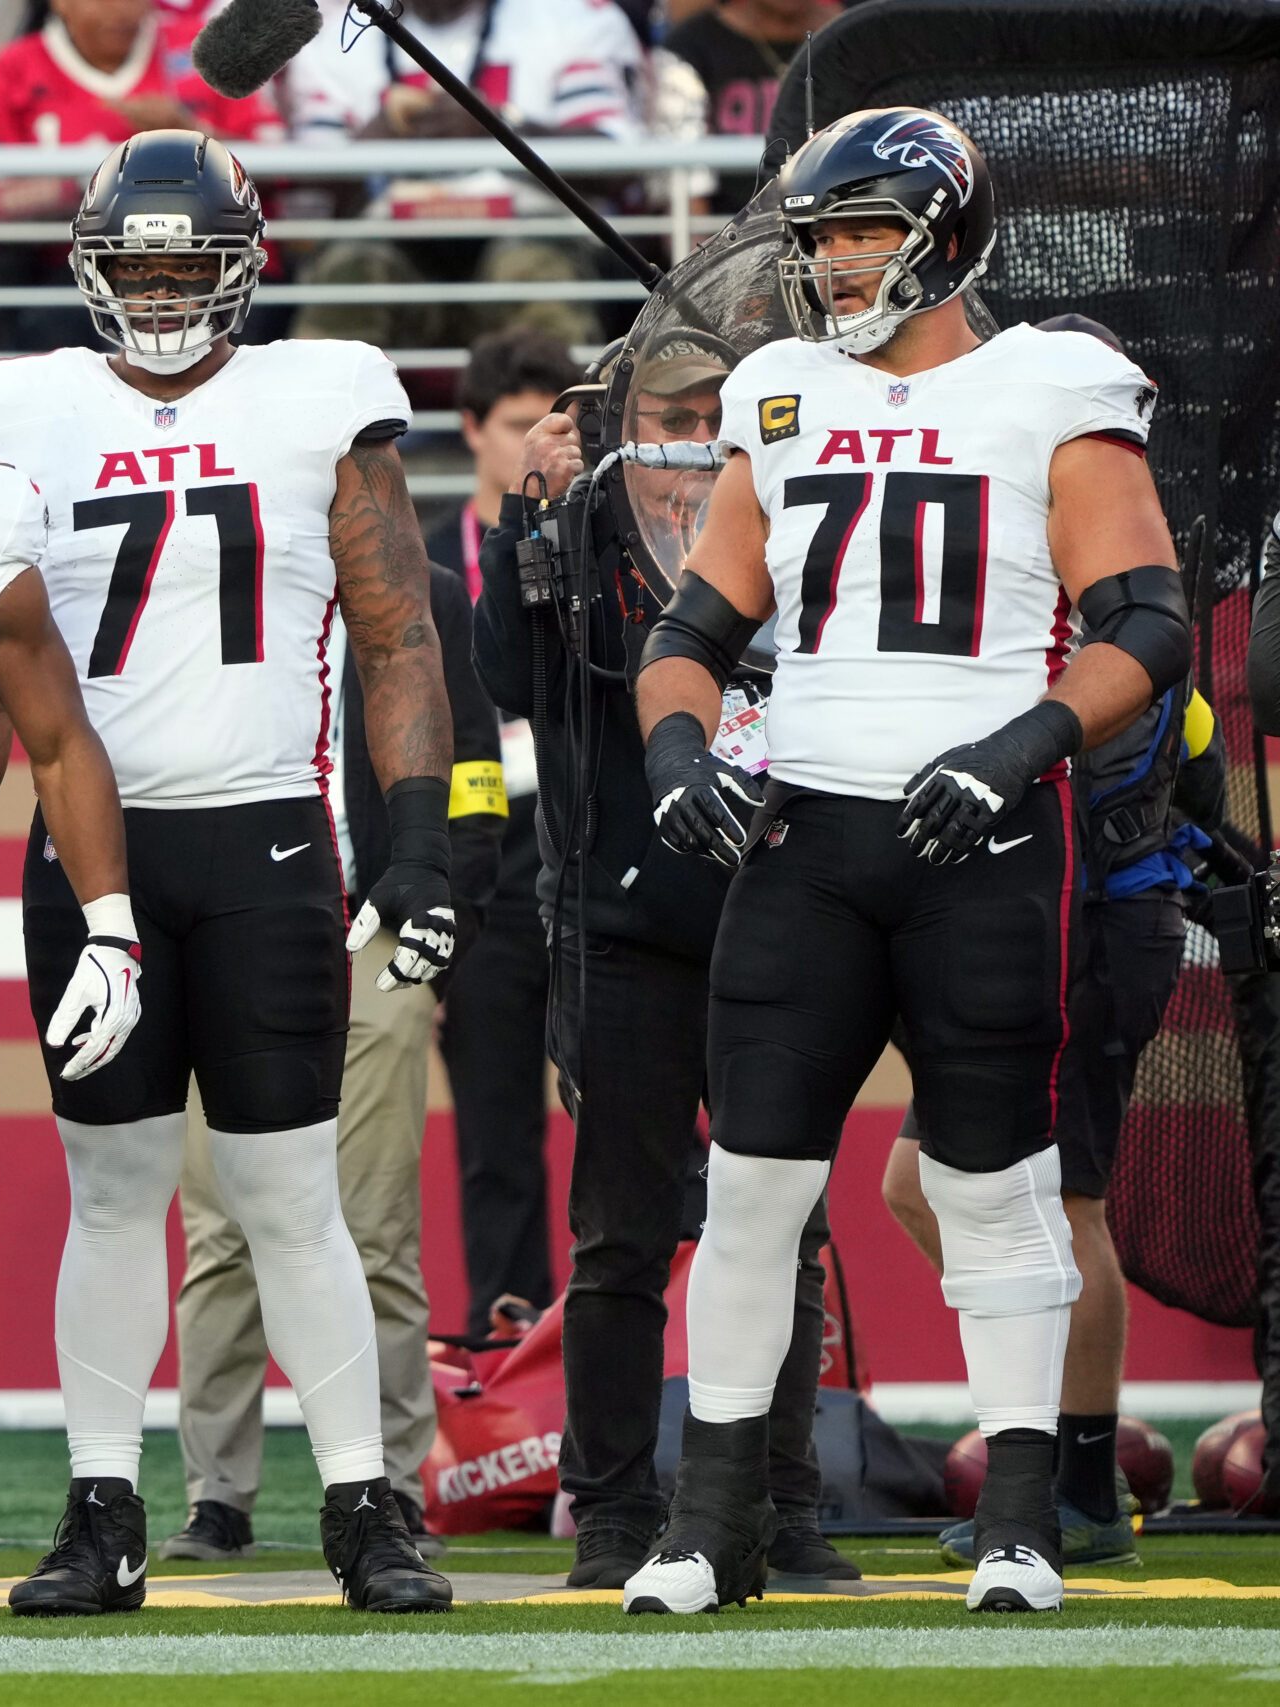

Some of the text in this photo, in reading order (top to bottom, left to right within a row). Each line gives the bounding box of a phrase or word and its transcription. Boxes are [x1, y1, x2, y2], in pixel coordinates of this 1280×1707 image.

[790, 197, 805, 205] ATL
[146, 220, 168, 228] ATL
[762, 397, 797, 430] C
[94, 443, 235, 489] ATL
[815, 429, 954, 465] ATL
[73, 482, 265, 679] 71
[783, 472, 990, 657] 70
[437, 1431, 563, 1505] KICKERS
